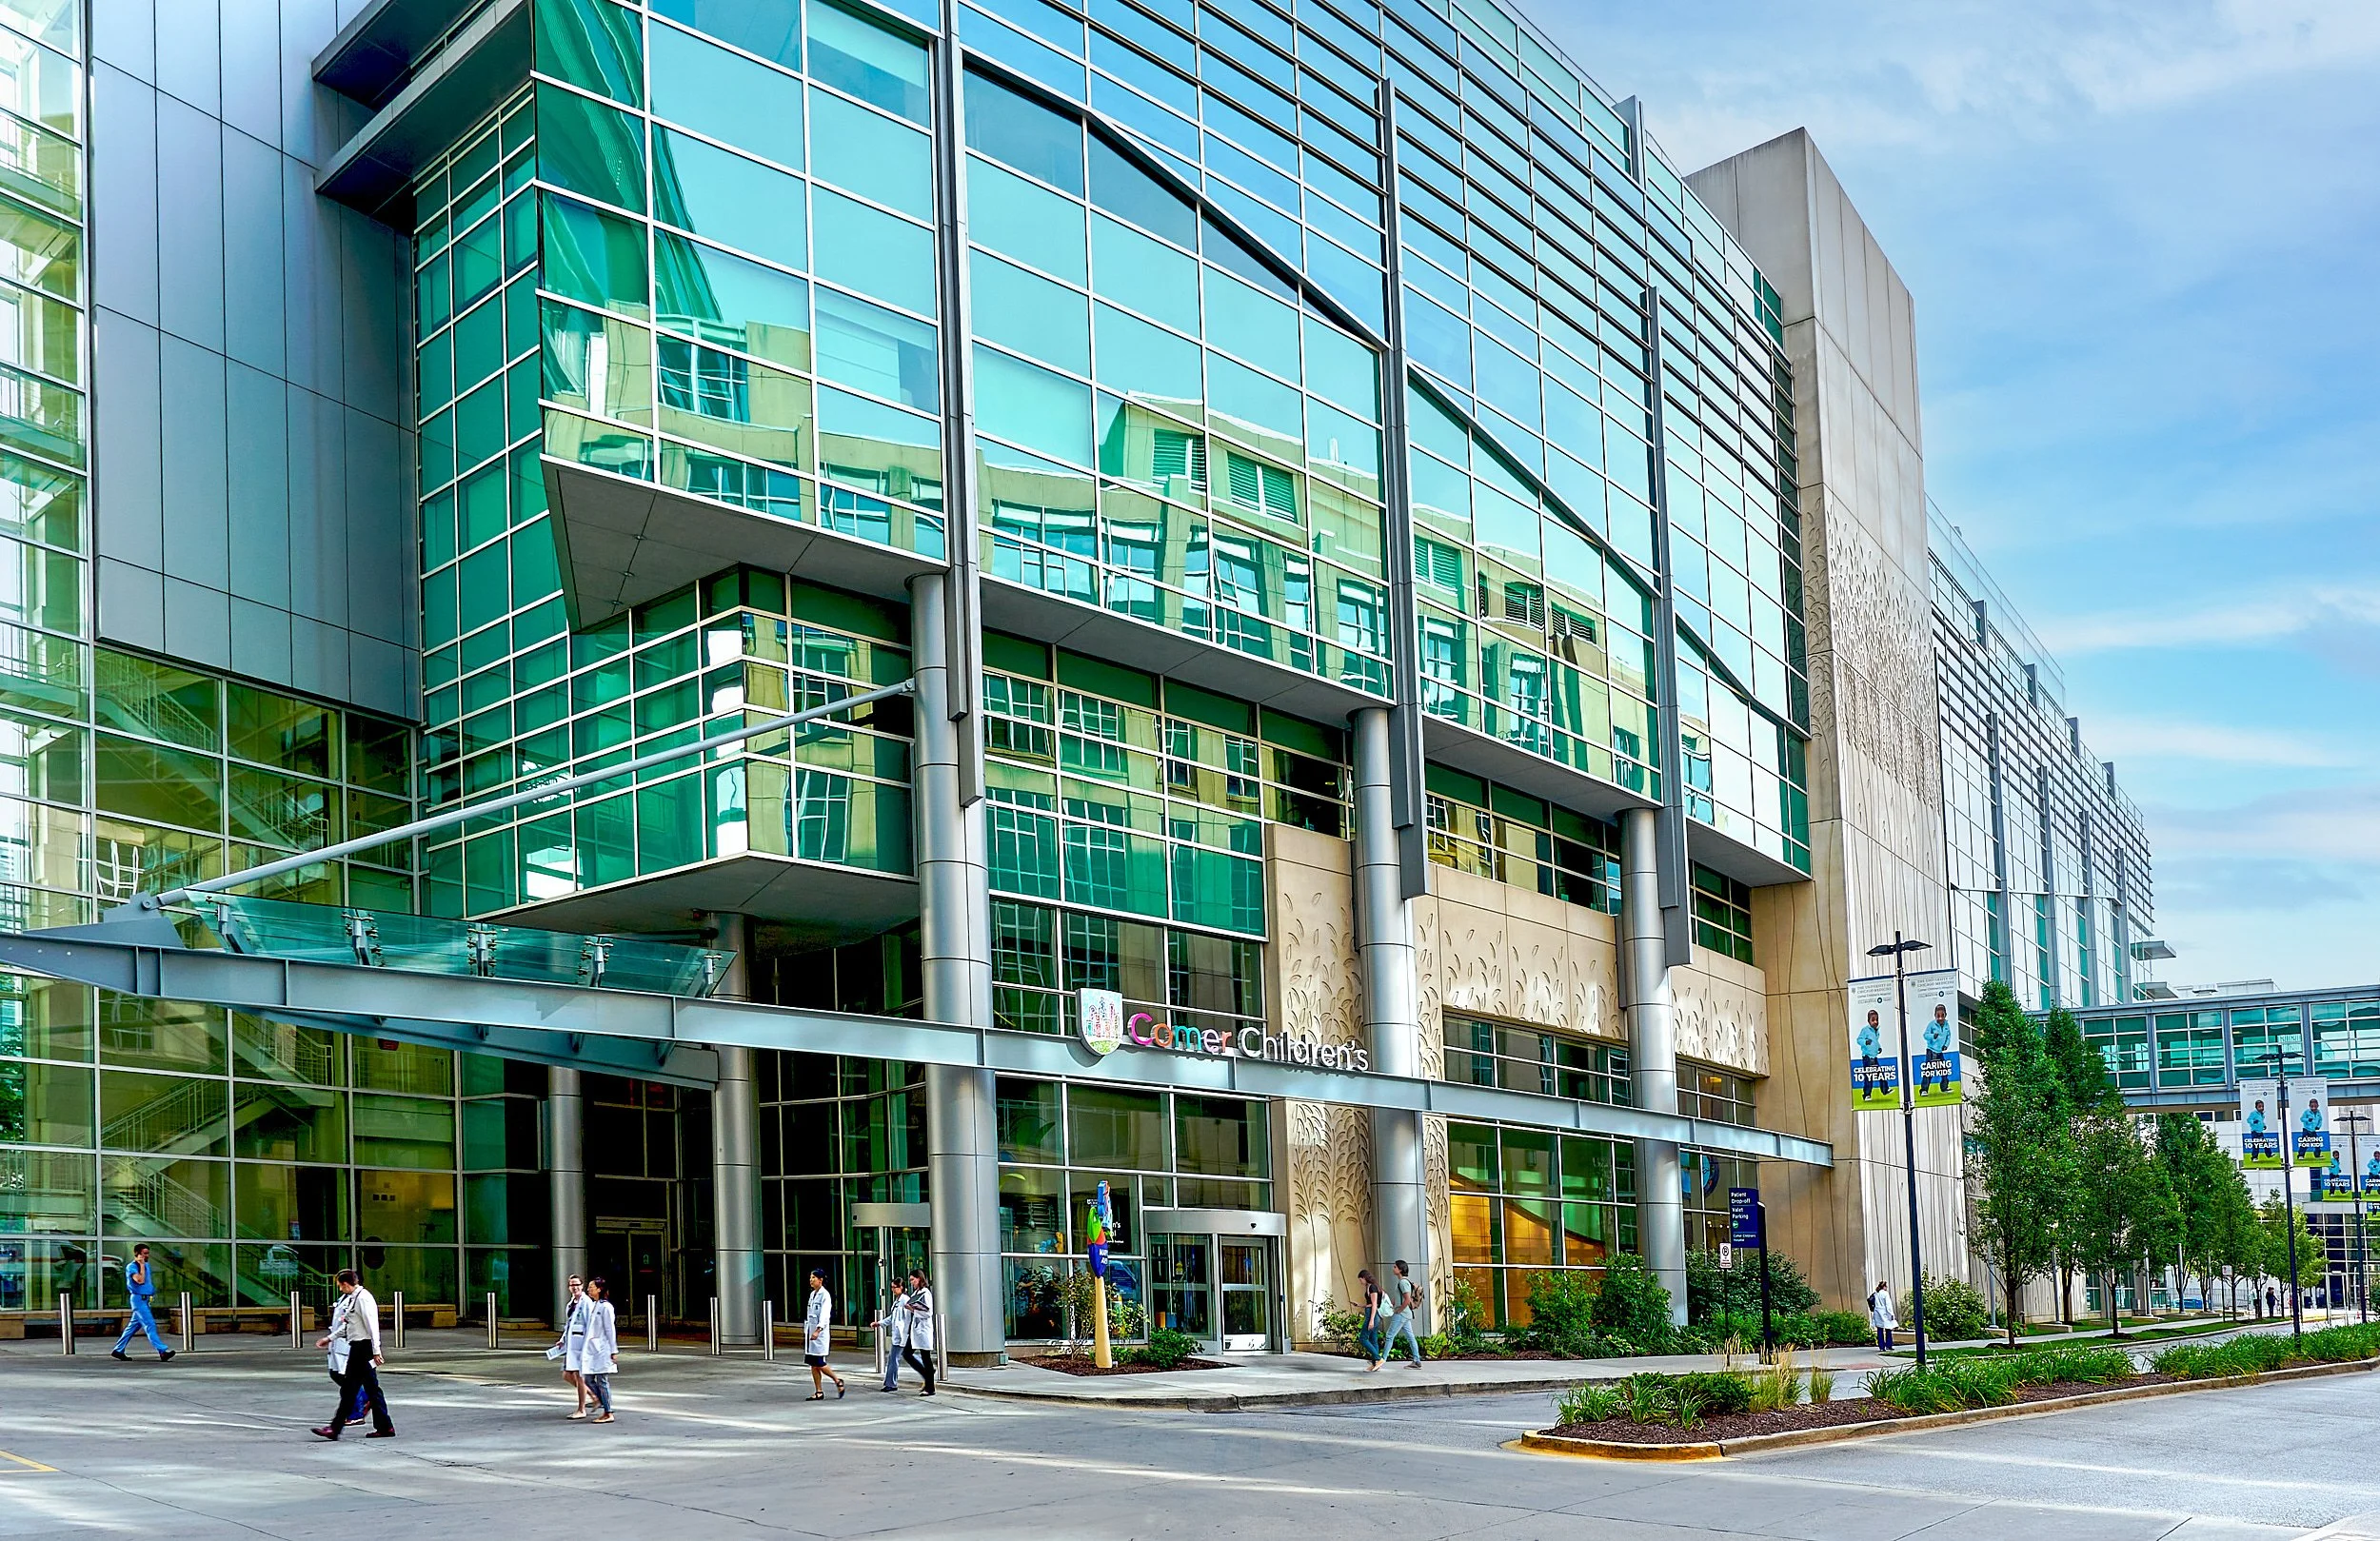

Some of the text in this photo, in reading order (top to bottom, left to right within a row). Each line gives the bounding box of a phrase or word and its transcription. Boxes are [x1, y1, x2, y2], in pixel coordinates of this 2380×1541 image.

[1127, 1012, 1369, 1072] Comer Children's
[1854, 1065, 1895, 1074] CELEBRATING
[1920, 1060, 1952, 1070] CARING
[1854, 1072, 1896, 1082] 10 YEARS
